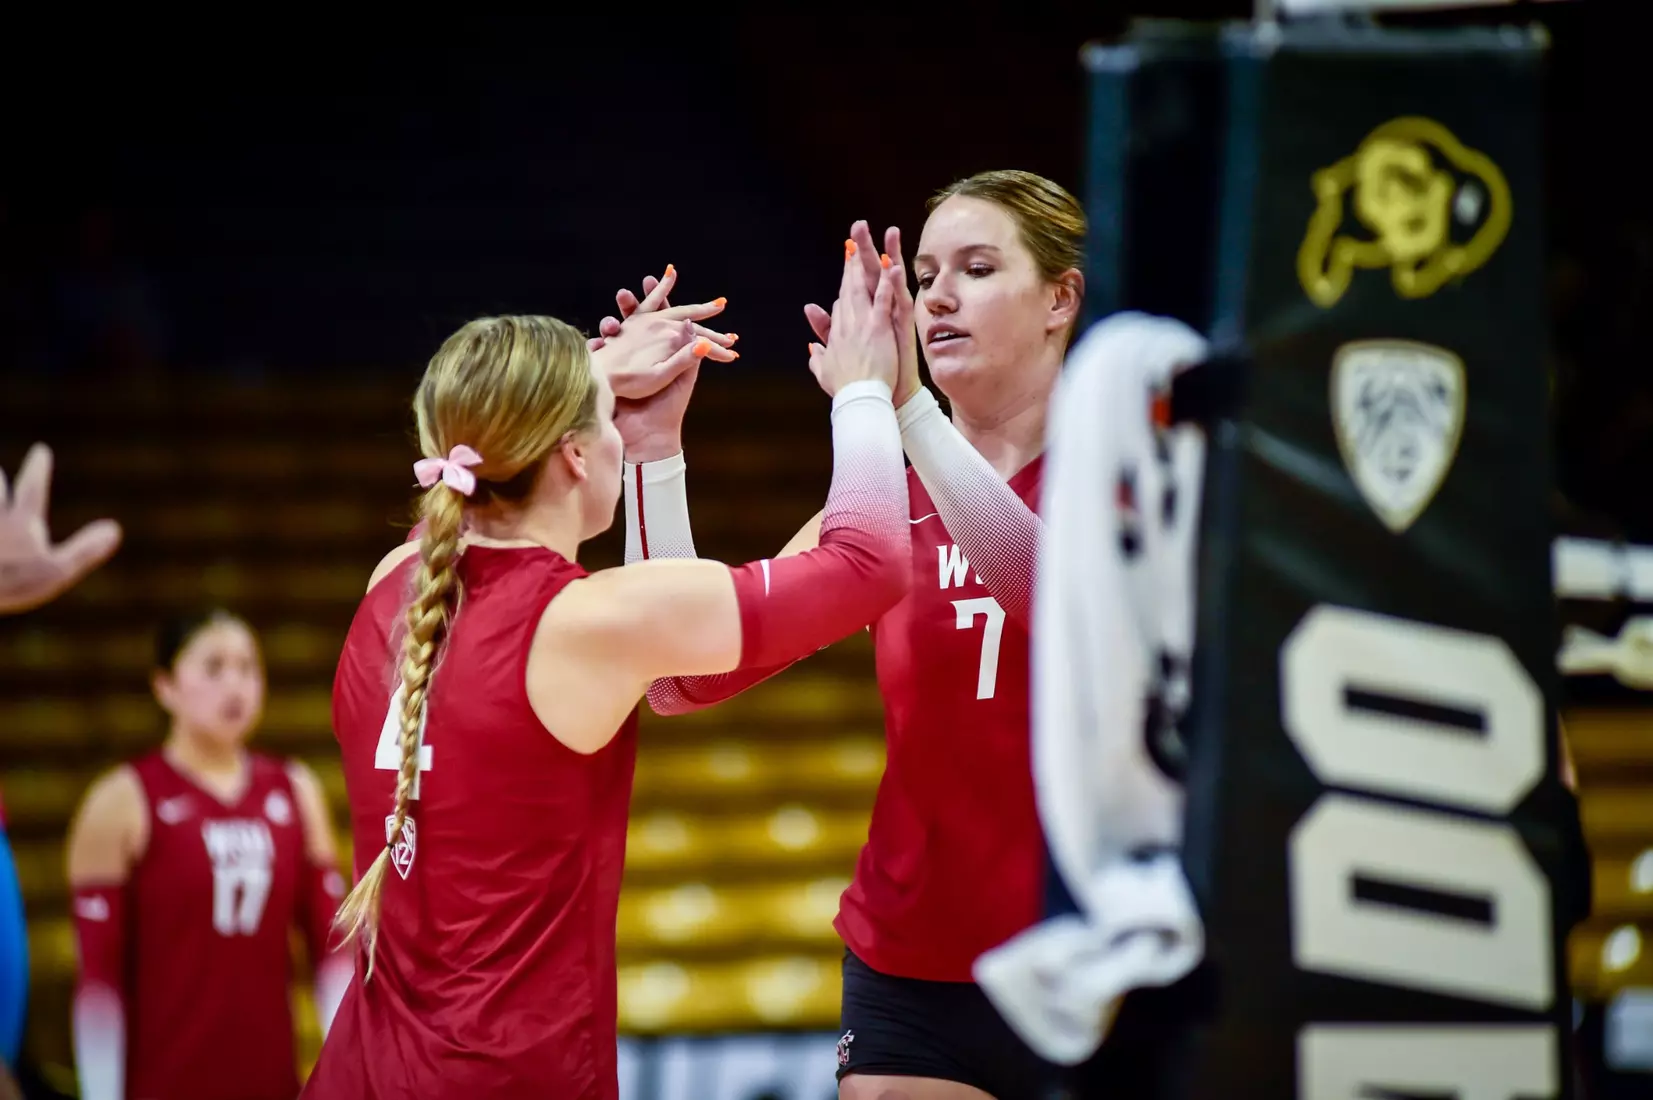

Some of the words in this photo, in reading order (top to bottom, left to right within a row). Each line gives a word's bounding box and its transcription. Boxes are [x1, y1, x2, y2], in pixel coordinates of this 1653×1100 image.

[950, 597, 1006, 700] 7
[374, 678, 433, 800] 4
[212, 868, 273, 937] 17
